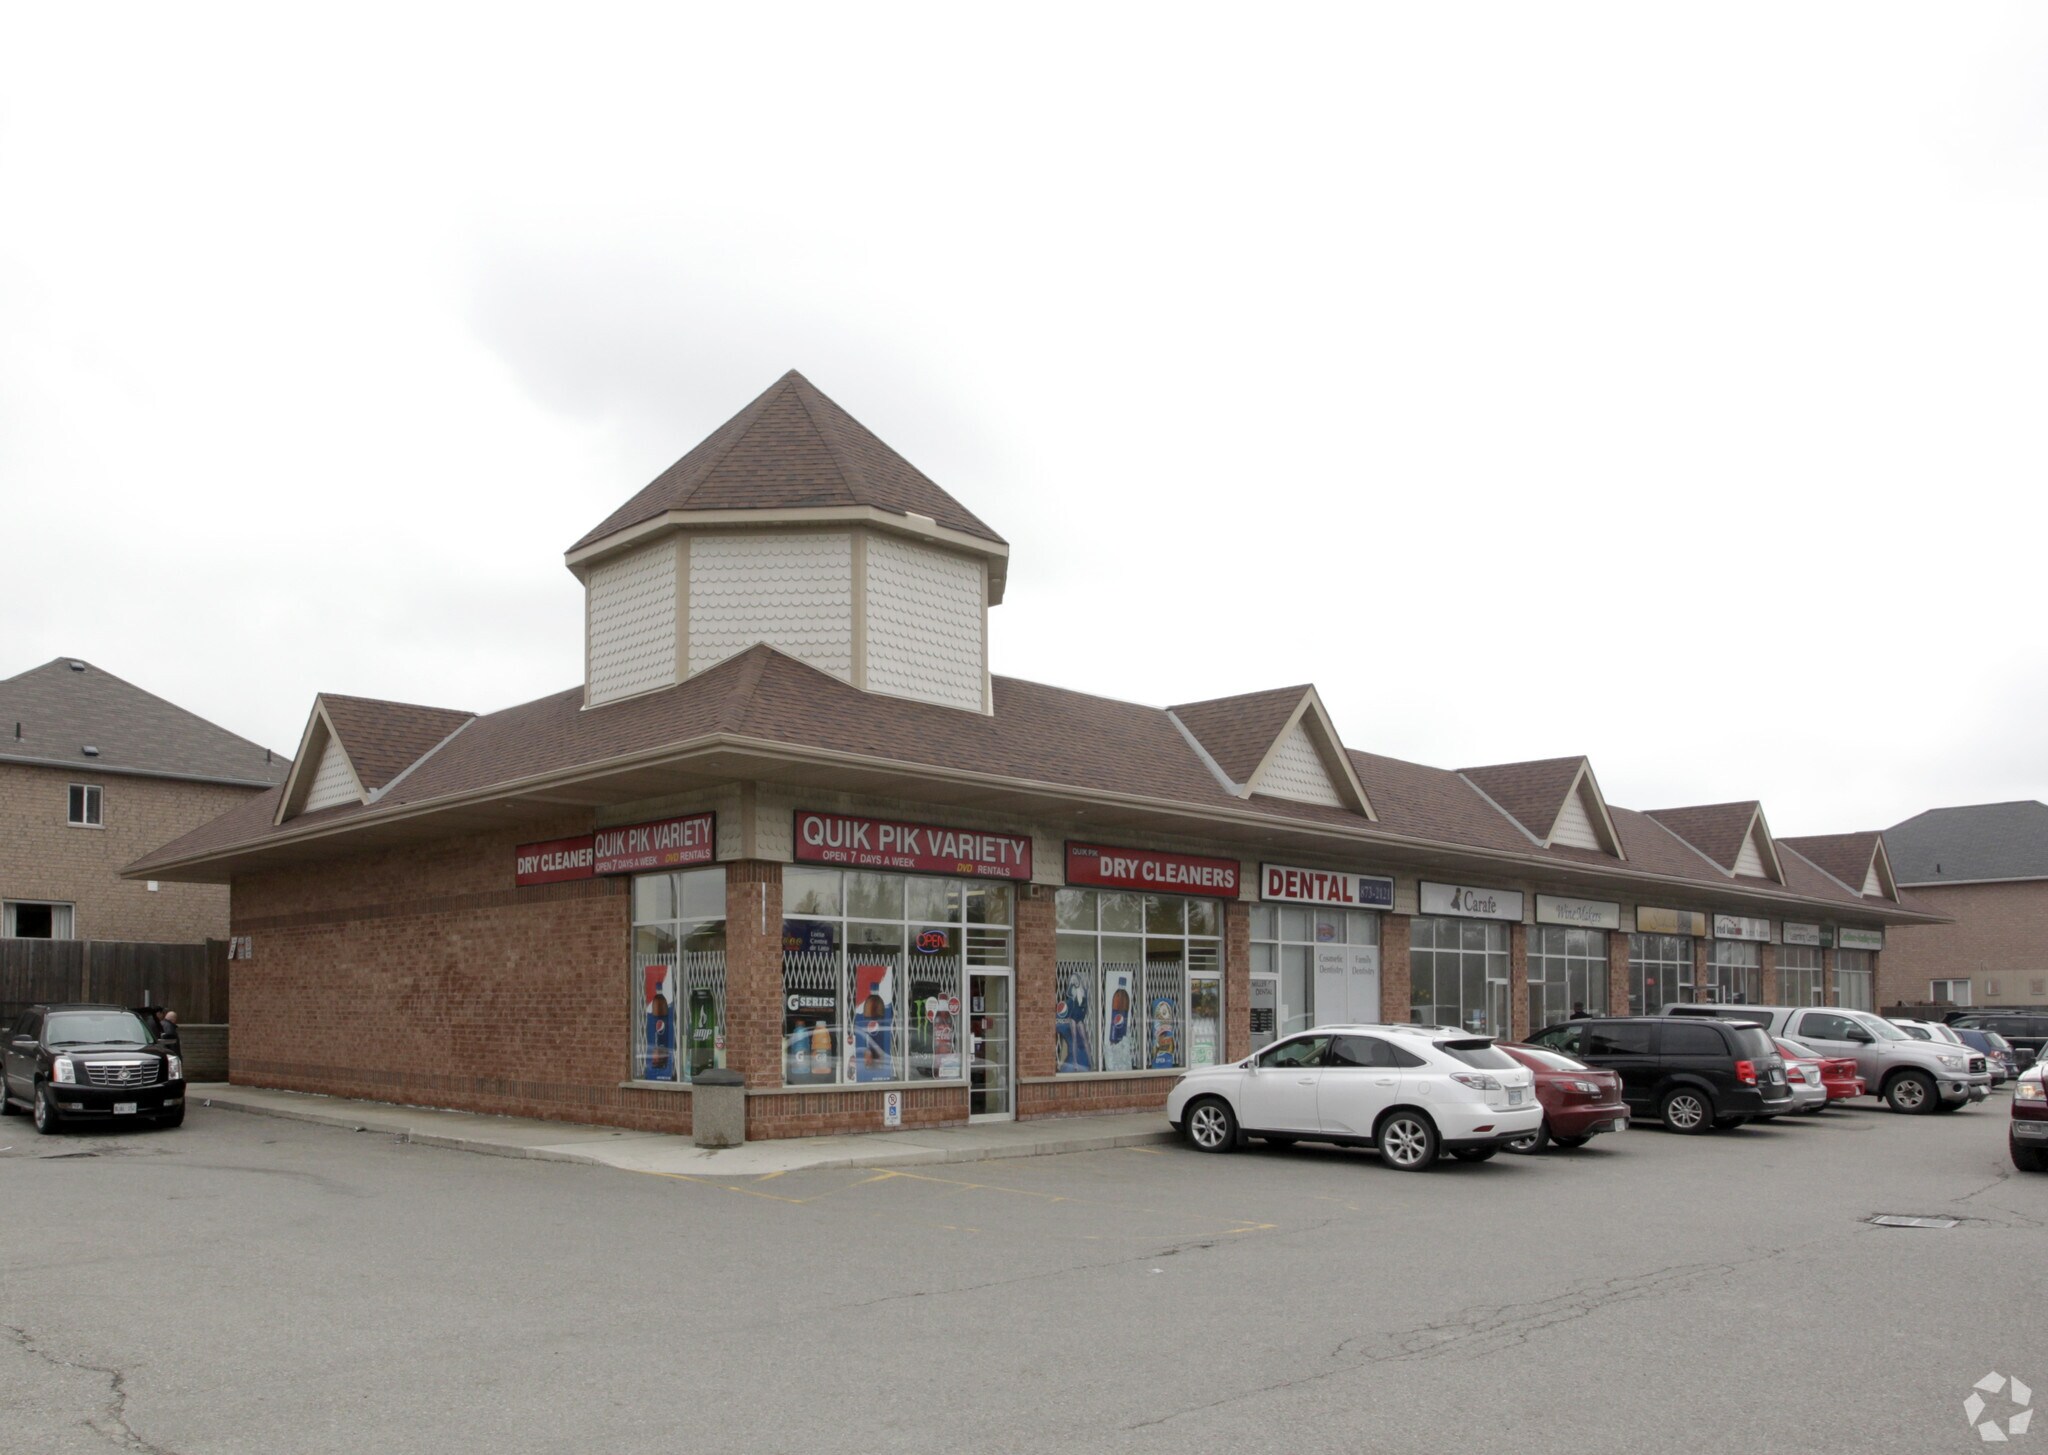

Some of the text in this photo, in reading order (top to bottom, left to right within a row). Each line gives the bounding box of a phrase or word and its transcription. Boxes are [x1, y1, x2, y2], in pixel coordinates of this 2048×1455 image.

[595, 817, 712, 858] QUIK PIK VARIETY
[803, 816, 1025, 865] QUIK PIK VARIETY
[665, 849, 710, 863] DVD RENTALS
[822, 850, 915, 868] OPEN 7 DAYS A WEEK
[1072, 847, 1088, 856] QUIK
[518, 855, 539, 875] DRY
[596, 855, 658, 872] OPEN 7 DAYS A WEEK
[957, 863, 1010, 876] DVD RENTALS
[1100, 856, 1235, 888] DRY CLEANERS
[1268, 868, 1353, 903] DENTAL
[1464, 890, 1497, 913] Carafe
[917, 932, 946, 948] OPEN
[1320, 964, 1344, 976] Dentistry
[1352, 966, 1375, 977] Dentistry
[787, 994, 835, 1011] G SERIES
